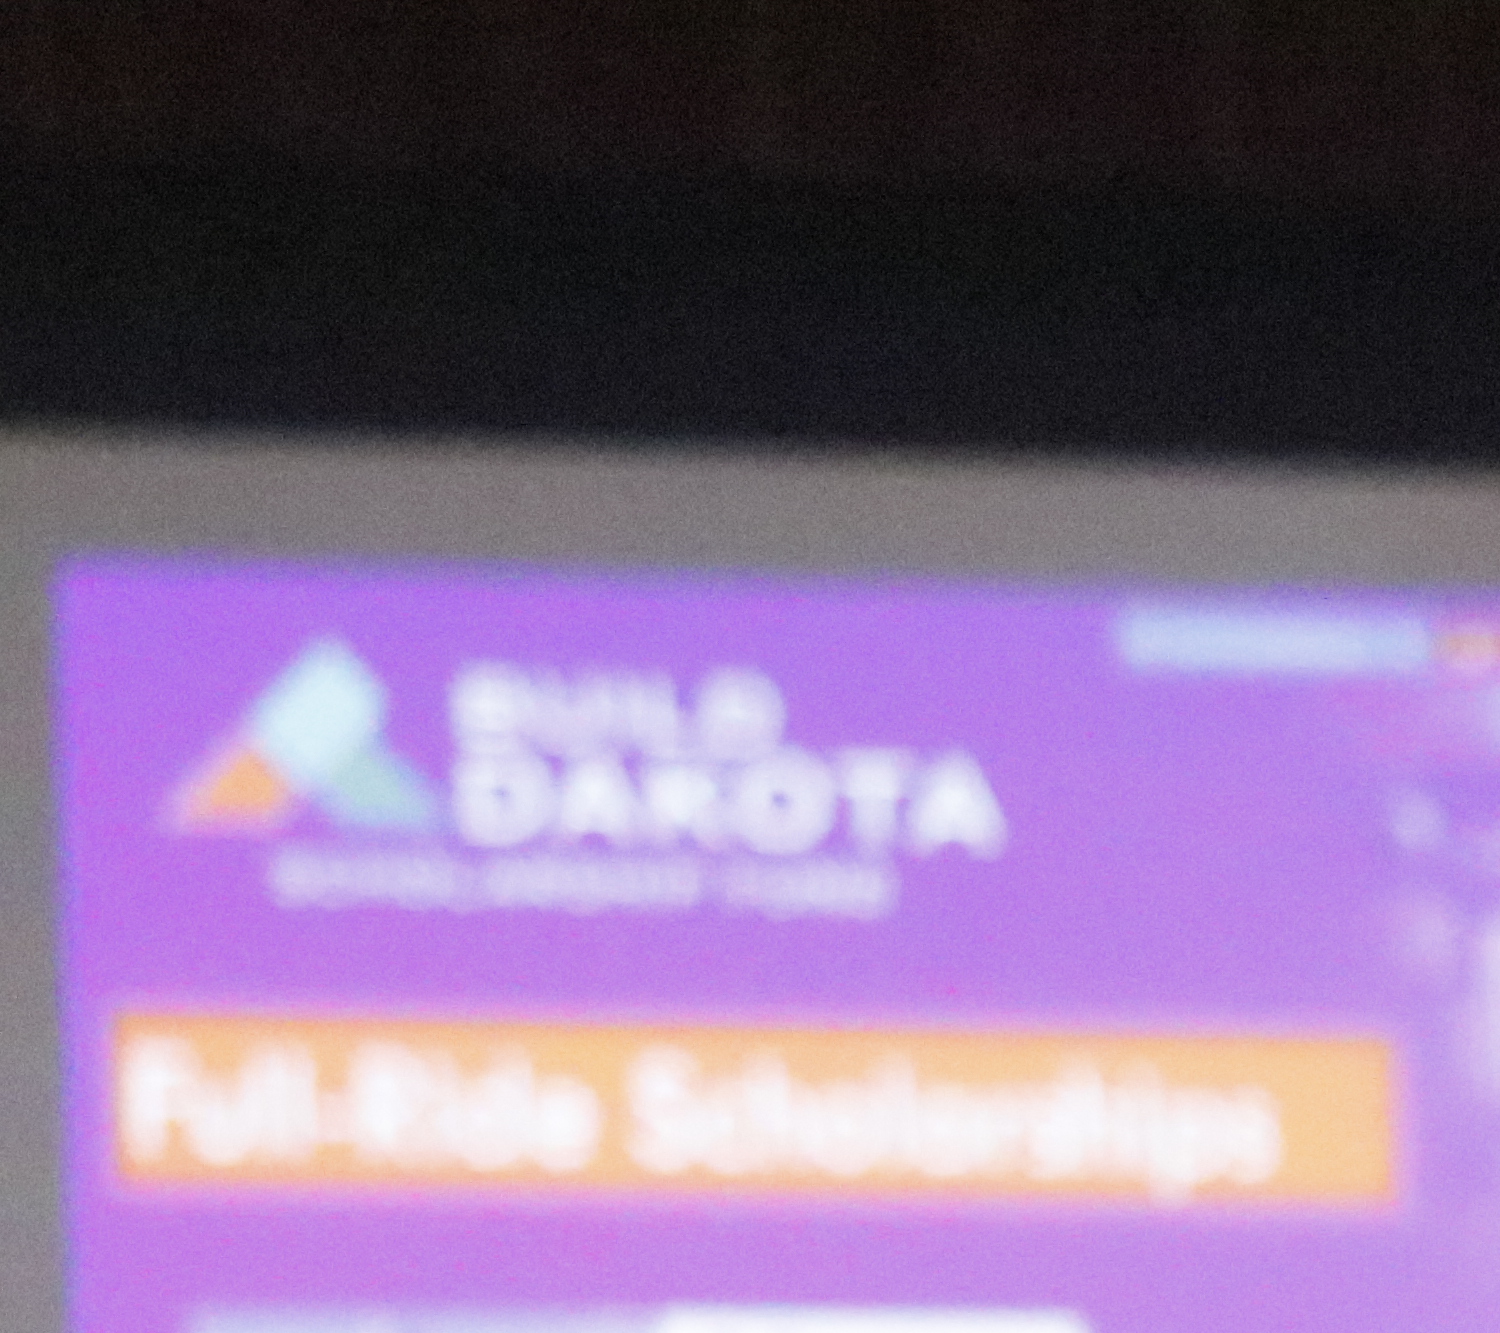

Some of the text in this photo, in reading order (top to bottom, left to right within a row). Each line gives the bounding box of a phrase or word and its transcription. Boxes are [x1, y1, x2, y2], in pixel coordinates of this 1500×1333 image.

[453, 748, 1004, 857] DAKOTA
[125, 1037, 1282, 1200] Full-Ride Scholarships
